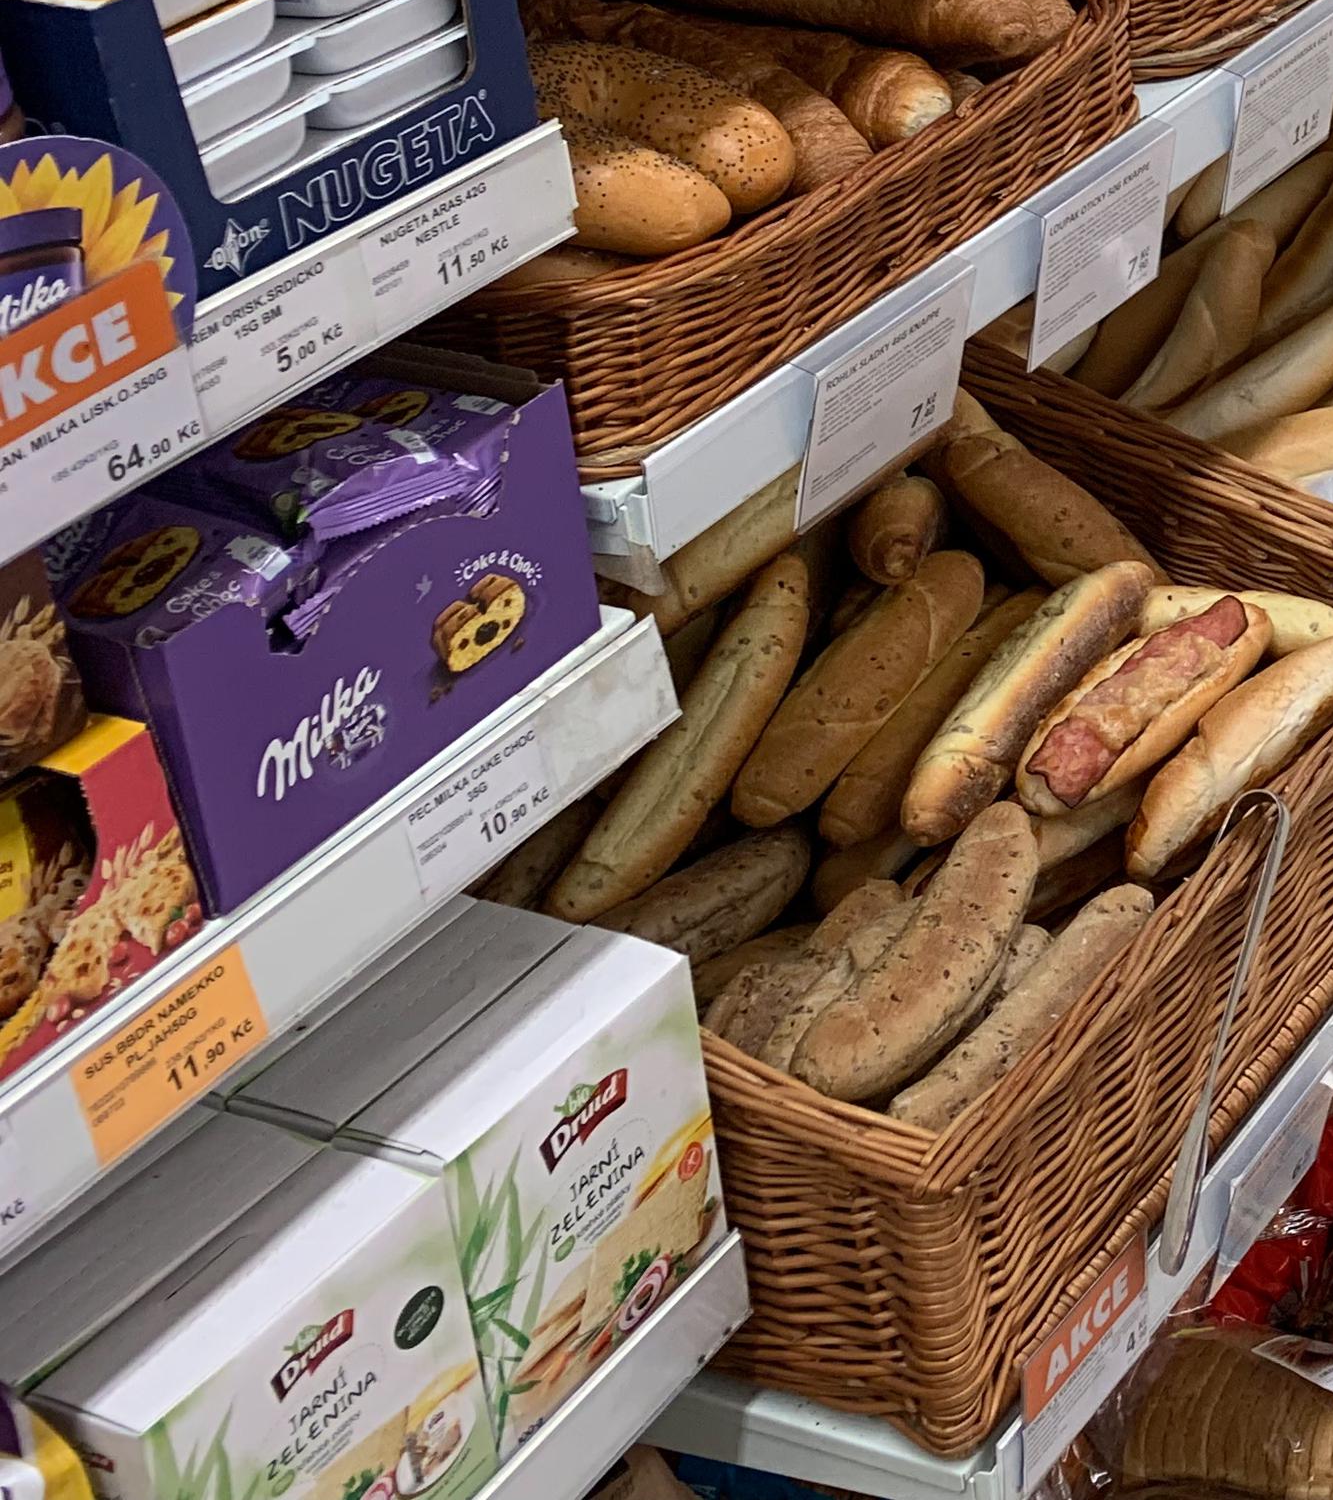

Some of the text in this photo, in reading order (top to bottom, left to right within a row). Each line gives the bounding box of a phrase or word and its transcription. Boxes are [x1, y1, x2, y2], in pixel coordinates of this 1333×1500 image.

[278, 96, 496, 250] NUGETA
[378, 213, 431, 249] NUGETA
[431, 181, 488, 222] ARAS.42G
[414, 212, 463, 248] NESTLE
[437, 248, 487, 287] 11,50
[490, 234, 510, 256] Kč
[1127, 255, 1139, 281] 7
[187, 319, 220, 348] REM
[234, 316, 260, 341] 15G
[261, 304, 283, 327] BM
[276, 340, 317, 373] 5,00
[321, 323, 344, 346] Kč
[0, 300, 138, 428] KCE
[0, 447, 27, 473] AN.
[30, 419, 79, 453] MILKA
[82, 366, 169, 424] LISK.O.350G
[910, 402, 924, 430] 7
[107, 436, 173, 483] 64,90
[176, 421, 202, 445] Kč
[460, 551, 496, 582] Cake
[509, 552, 538, 581] Choc
[255, 665, 384, 802] Milka
[407, 776, 470, 827] PEC.MILKA
[470, 752, 504, 781] CAKE
[502, 729, 537, 759] CHOC
[480, 803, 528, 844] 10,90
[531, 786, 551, 808] Kč
[156, 964, 226, 1025] NAMEKKO
[167, 1040, 226, 1092] 11,90
[230, 1018, 255, 1044] Kč
[548, 1073, 619, 1161] Druid
[549, 1145, 646, 1246] ZELENINA
[567, 1136, 623, 1203] JARNÍ
[278, 1313, 346, 1391] Druid
[1045, 1264, 1129, 1393] AKCE
[266, 1370, 379, 1482] ZELENINA
[287, 1364, 349, 1436] JARNÍ
